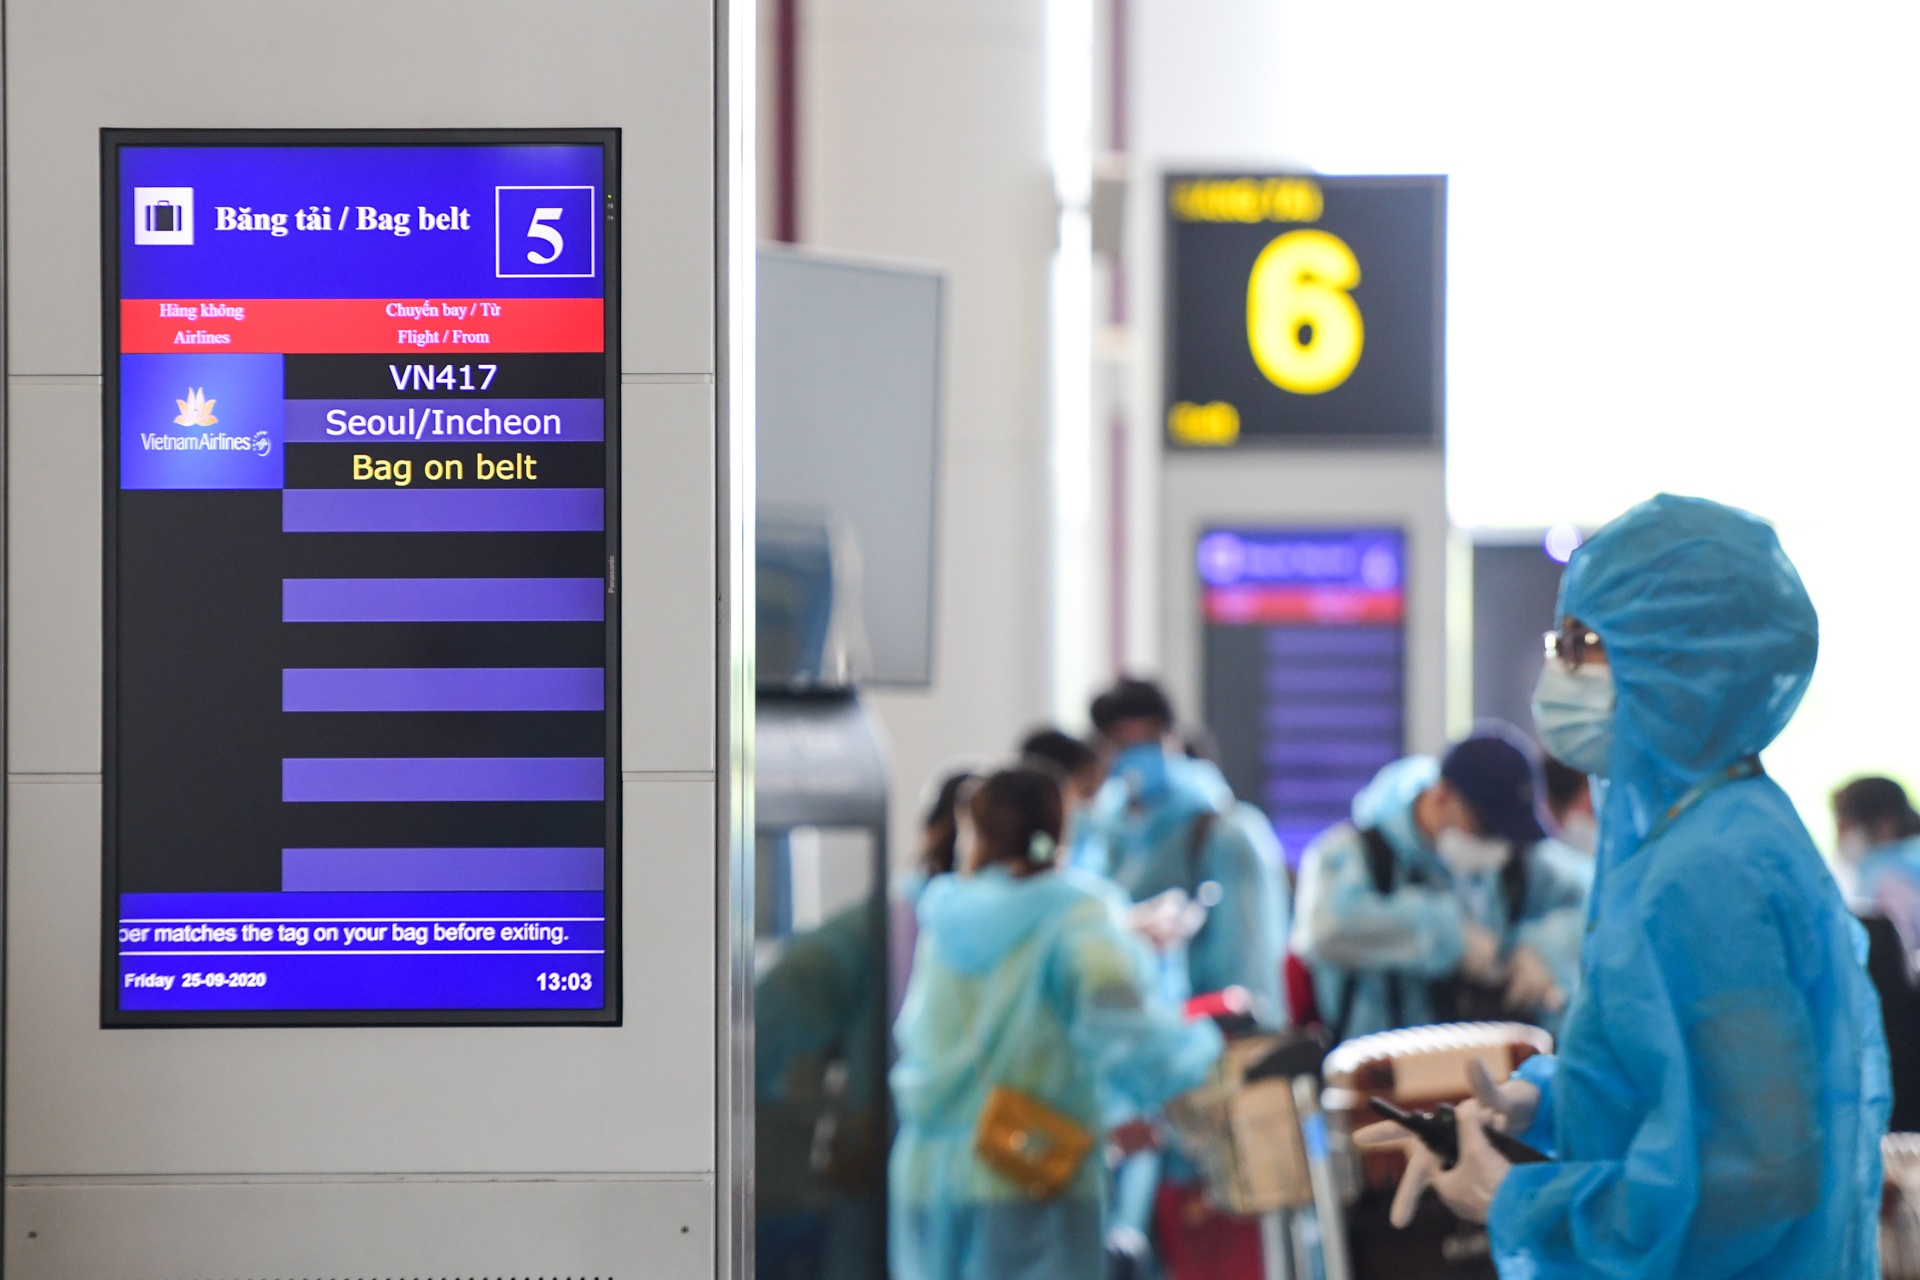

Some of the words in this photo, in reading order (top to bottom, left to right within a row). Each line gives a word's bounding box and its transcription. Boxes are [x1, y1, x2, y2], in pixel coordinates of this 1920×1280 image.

[214, 206, 288, 236] Băng
[295, 206, 332, 231] tải
[338, 206, 350, 231] /
[355, 206, 411, 236] Bag
[418, 206, 471, 231] belt
[526, 207, 564, 265] 5
[200, 303, 245, 321] không
[442, 302, 468, 320] bay
[469, 302, 478, 317] /
[480, 302, 502, 317] Từ
[1246, 229, 1364, 395] 6
[173, 329, 231, 345] Airlines
[397, 329, 440, 348] Flight
[442, 329, 450, 344] /
[452, 329, 490, 344] From
[389, 364, 497, 391] VN417
[325, 408, 562, 440] Seoul/Incheon
[353, 454, 412, 486] Bag
[424, 459, 463, 480] on
[476, 453, 537, 480] belt
[154, 924, 238, 943] matches
[241, 924, 273, 942] the
[277, 924, 309, 946] tag
[313, 926, 339, 942] on
[343, 925, 388, 946] your
[391, 923, 428, 945] bag
[433, 922, 496, 941] before
[500, 922, 569, 945] exiting.
[124, 973, 175, 991] Friday
[181, 972, 267, 988] 25-09-2020
[536, 972, 593, 991] 13:03
